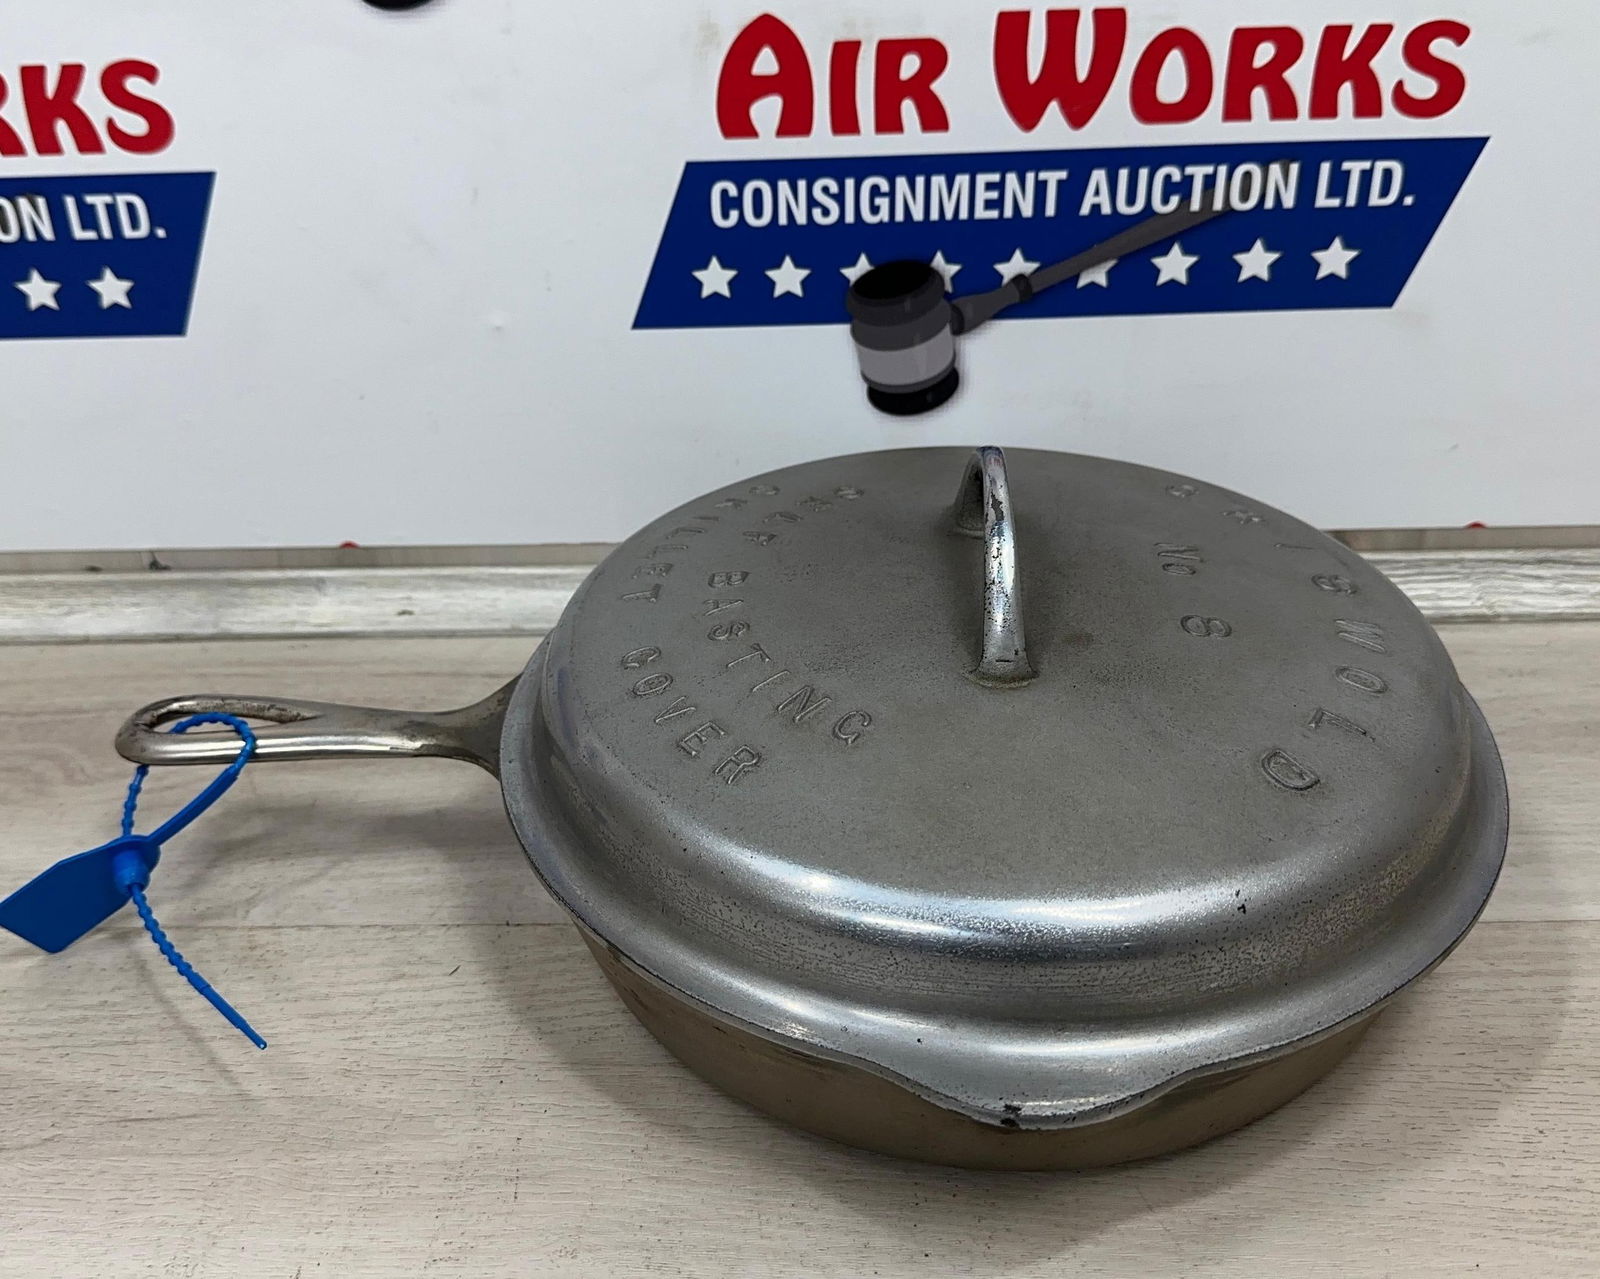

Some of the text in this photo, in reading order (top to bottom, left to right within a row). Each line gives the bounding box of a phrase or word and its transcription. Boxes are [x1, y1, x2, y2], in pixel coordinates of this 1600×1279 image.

[717, 8, 1471, 138] AIR WORKS
[64, 193, 167, 241] LTD.
[711, 160, 1414, 228] CONSIGNMENT AUCTION LTD.
[703, 570, 873, 746] BASTING
[1165, 483, 1389, 793] GRISWOLD
[620, 646, 762, 785] COVER
